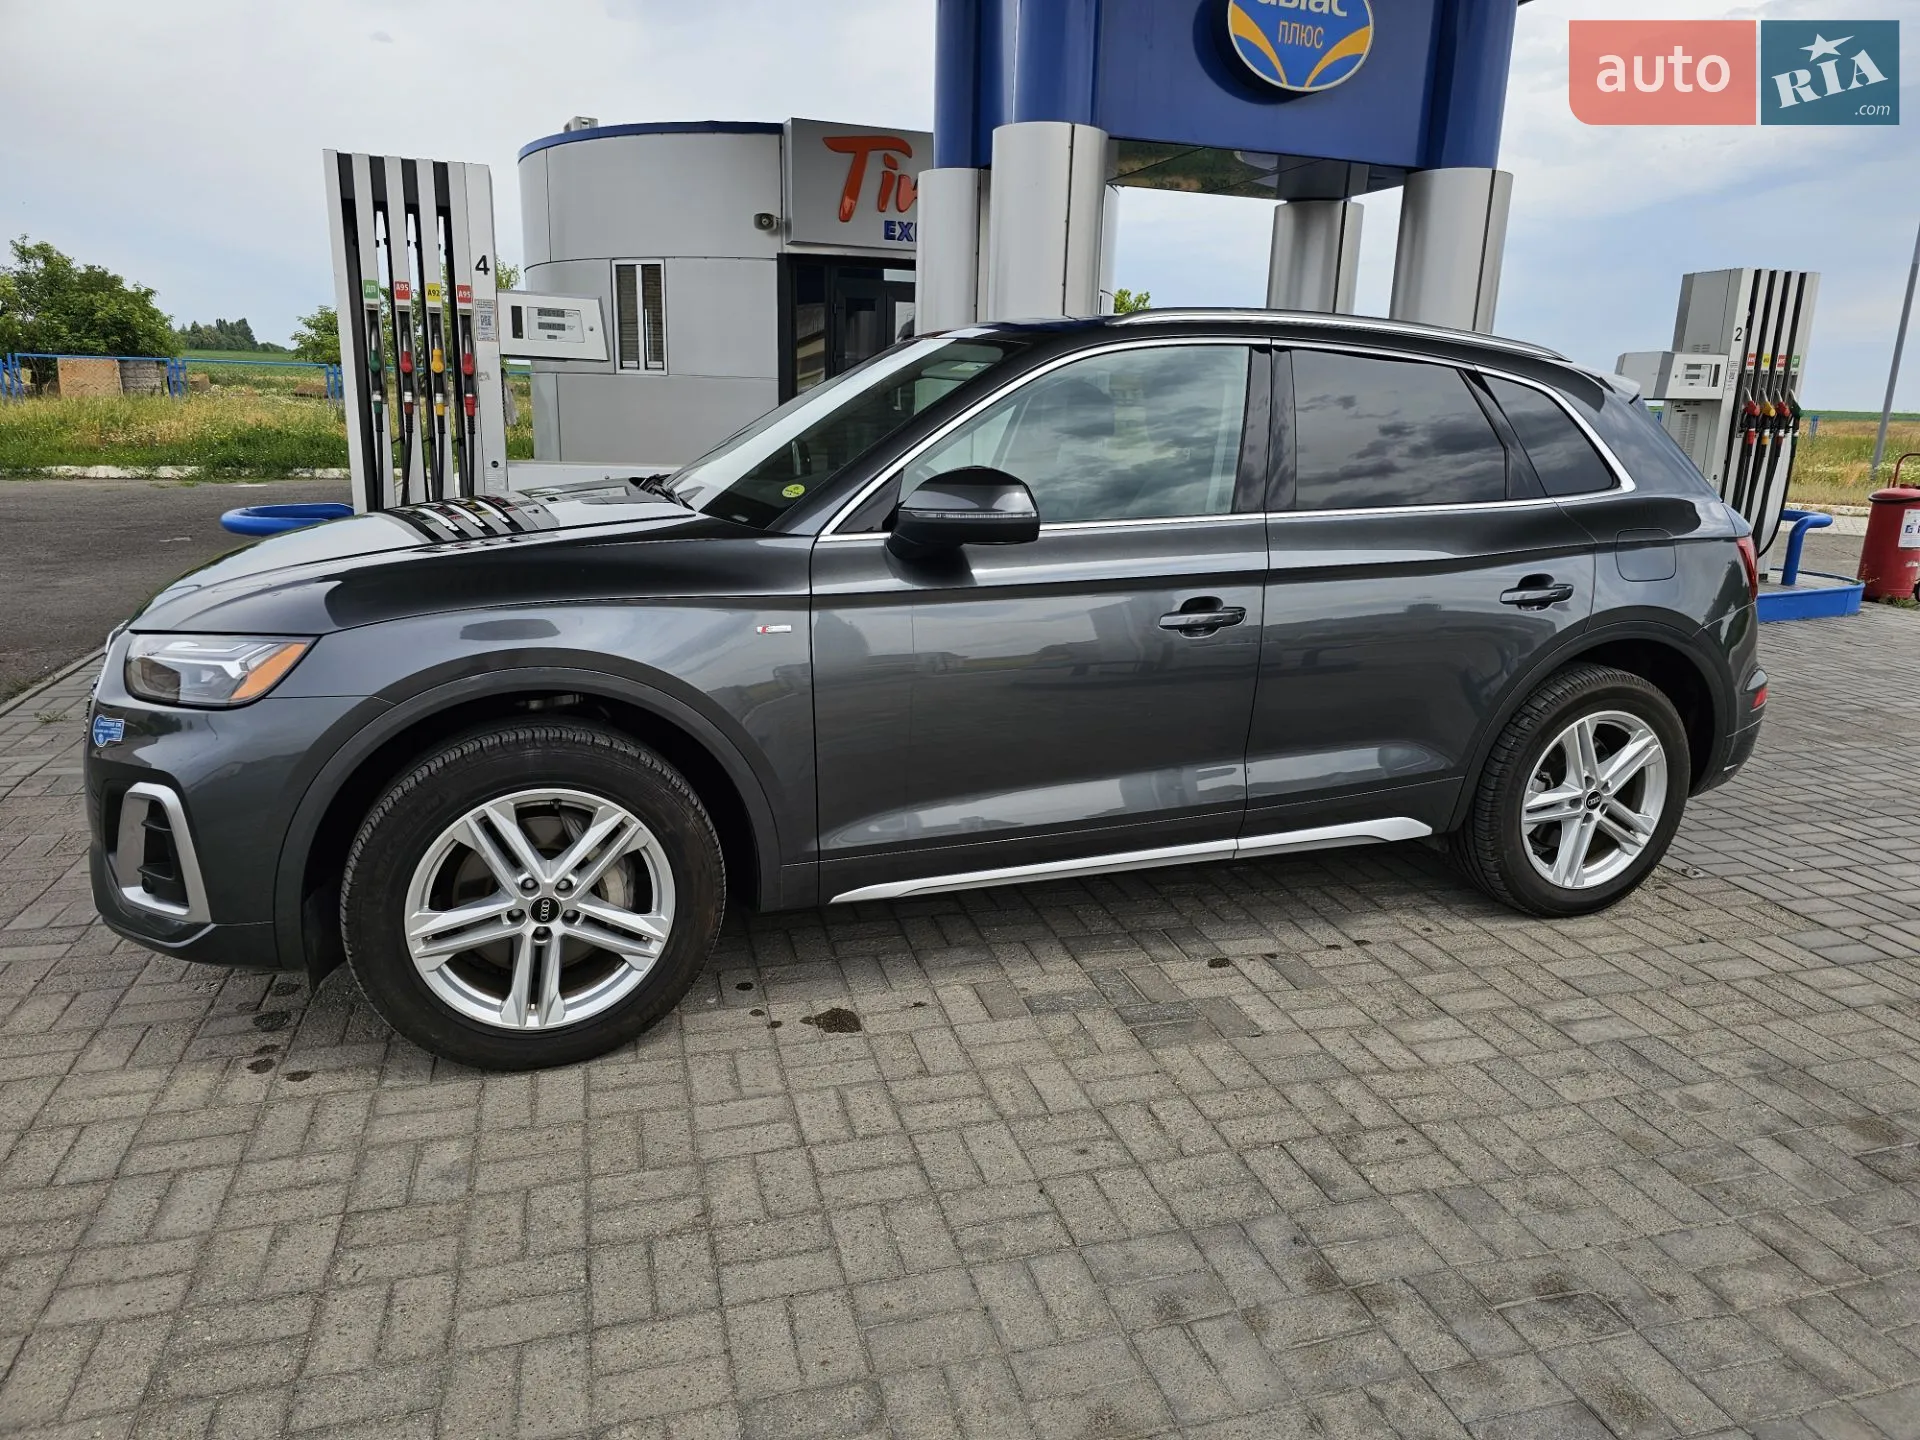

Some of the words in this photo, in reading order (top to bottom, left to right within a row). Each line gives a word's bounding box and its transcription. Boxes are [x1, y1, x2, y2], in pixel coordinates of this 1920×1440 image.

[1278, 20, 1324, 49] ПЛЮС
[883, 220, 918, 242] EX
[475, 254, 490, 275] 4
[1734, 327, 1743, 342] 2
